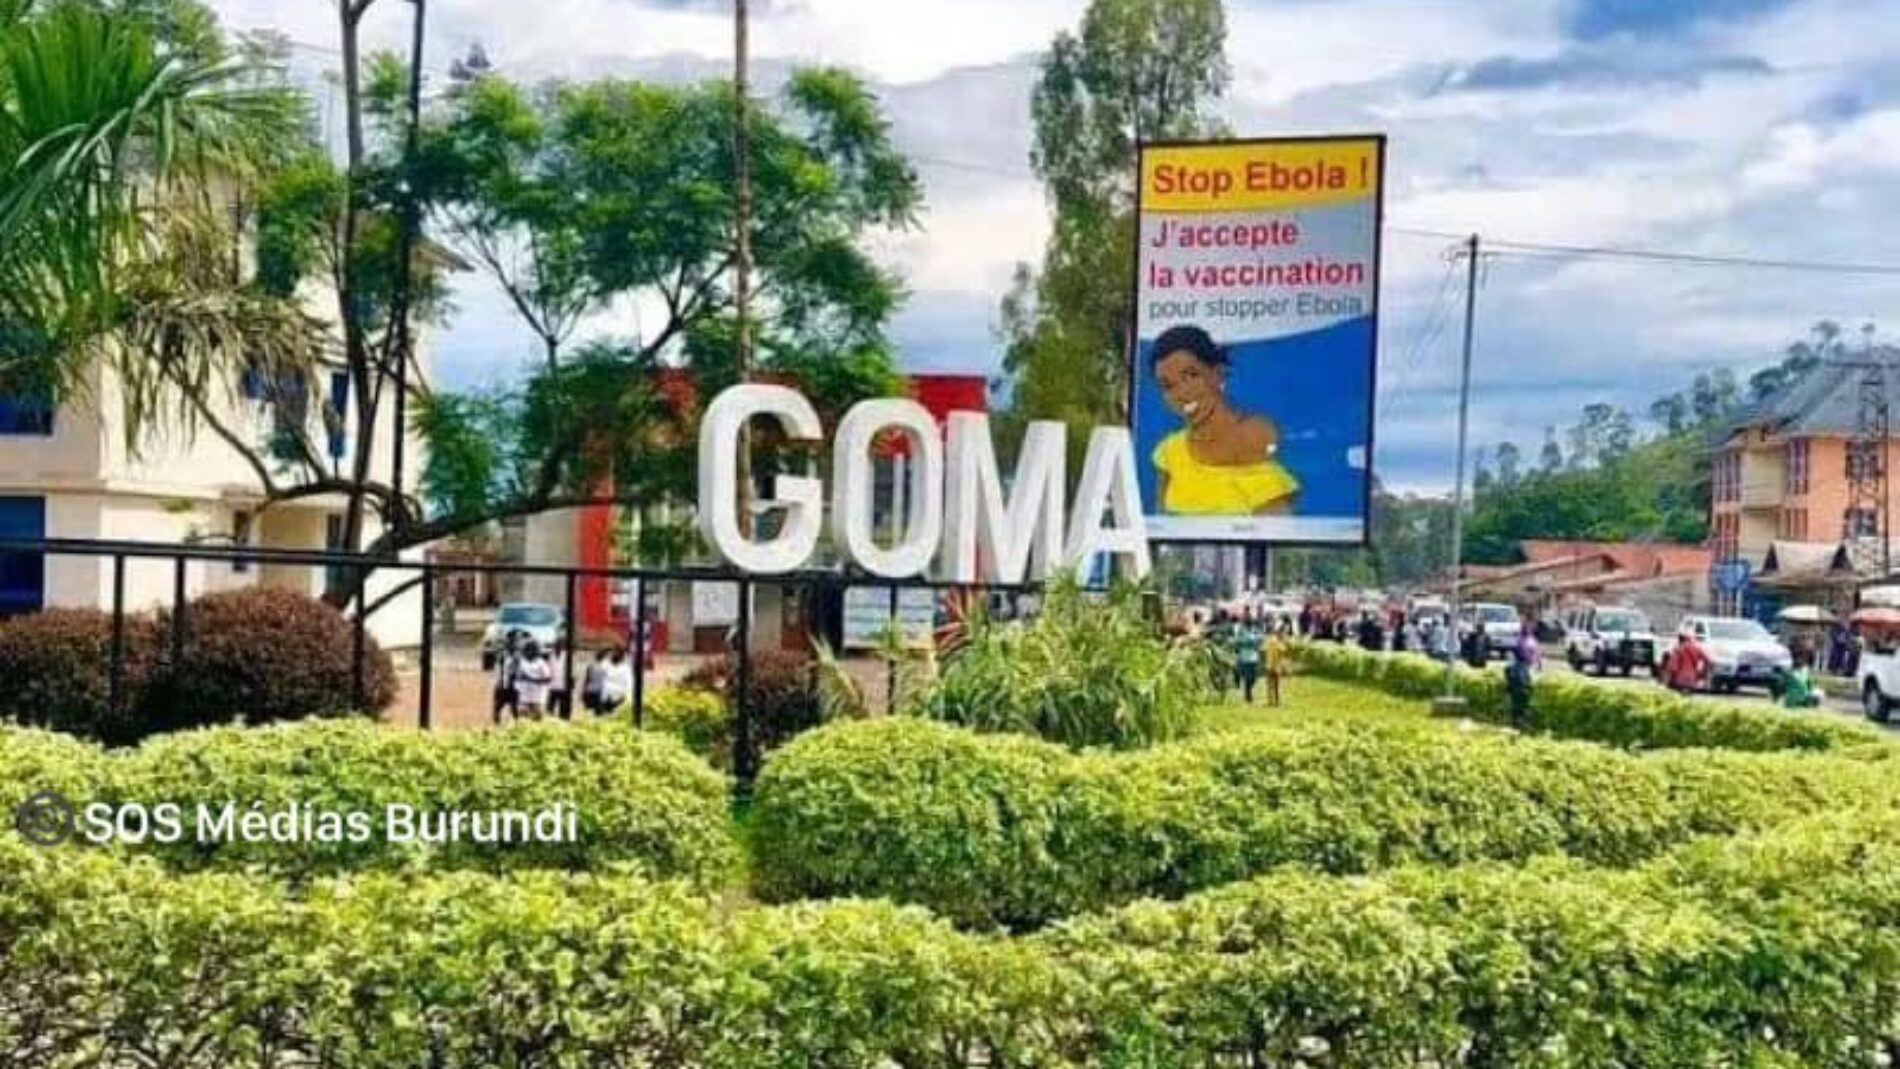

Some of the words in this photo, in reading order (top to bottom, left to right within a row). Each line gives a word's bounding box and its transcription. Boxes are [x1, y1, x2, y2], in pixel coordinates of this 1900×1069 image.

[1152, 163, 1232, 198] Stop
[1247, 160, 1346, 191] Ebola
[1151, 220, 1298, 249] J'accepte
[1150, 260, 1173, 289] la
[1184, 257, 1364, 287] vaccination
[1149, 301, 1197, 320] pour
[1204, 297, 1290, 320] stopper
[1296, 292, 1362, 317] Ebola
[699, 384, 1151, 588] GOMA
